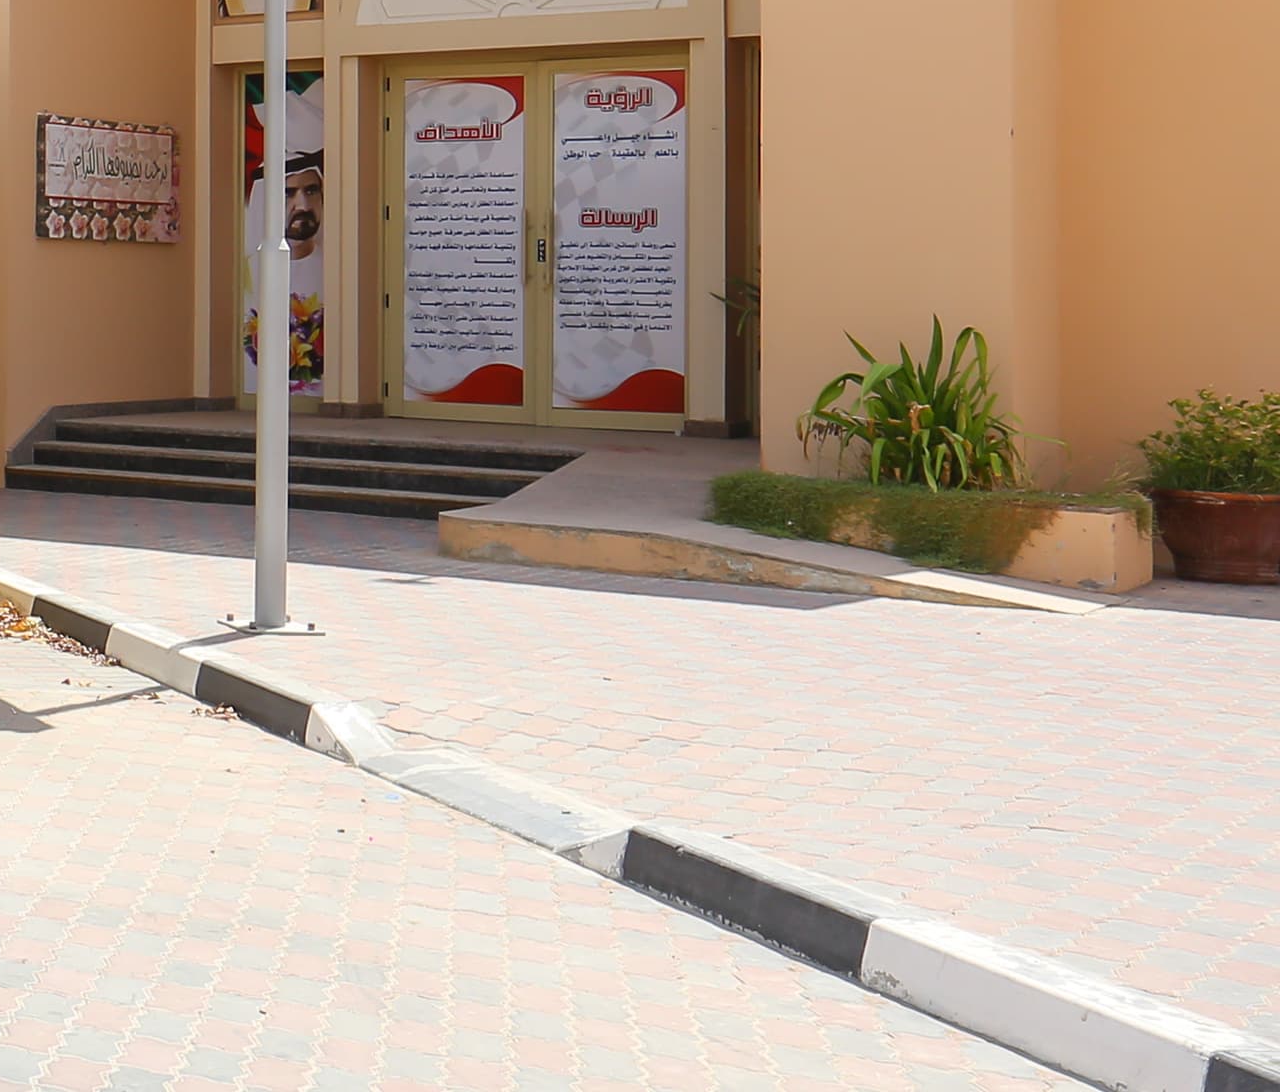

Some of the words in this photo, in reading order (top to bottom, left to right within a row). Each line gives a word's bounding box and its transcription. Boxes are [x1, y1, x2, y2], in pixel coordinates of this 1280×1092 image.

[585, 86, 653, 112] الرؤية
[415, 117, 502, 142] الأهداف
[580, 207, 657, 232] الرسالة
